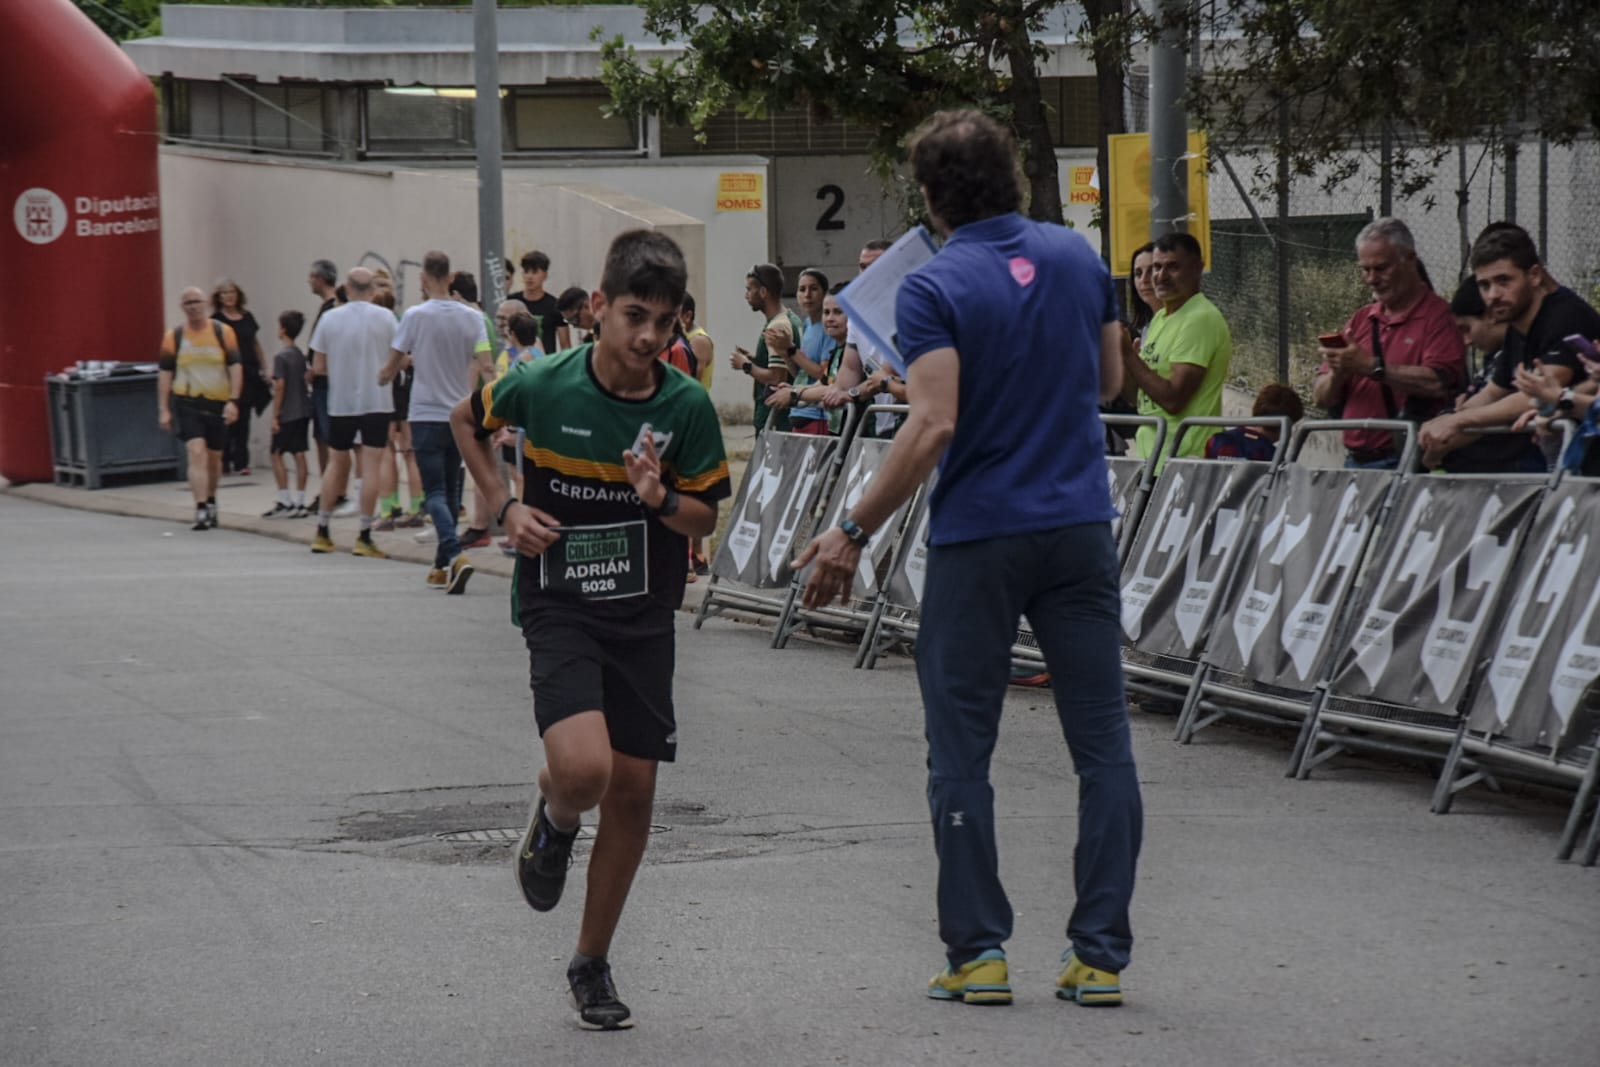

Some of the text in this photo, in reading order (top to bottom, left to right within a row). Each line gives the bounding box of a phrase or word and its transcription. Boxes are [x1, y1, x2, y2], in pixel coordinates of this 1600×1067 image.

[717, 198, 762, 209] HOMES
[816, 184, 845, 231] 2
[564, 557, 631, 580] ADRIÁN
[581, 578, 617, 593] 5026
